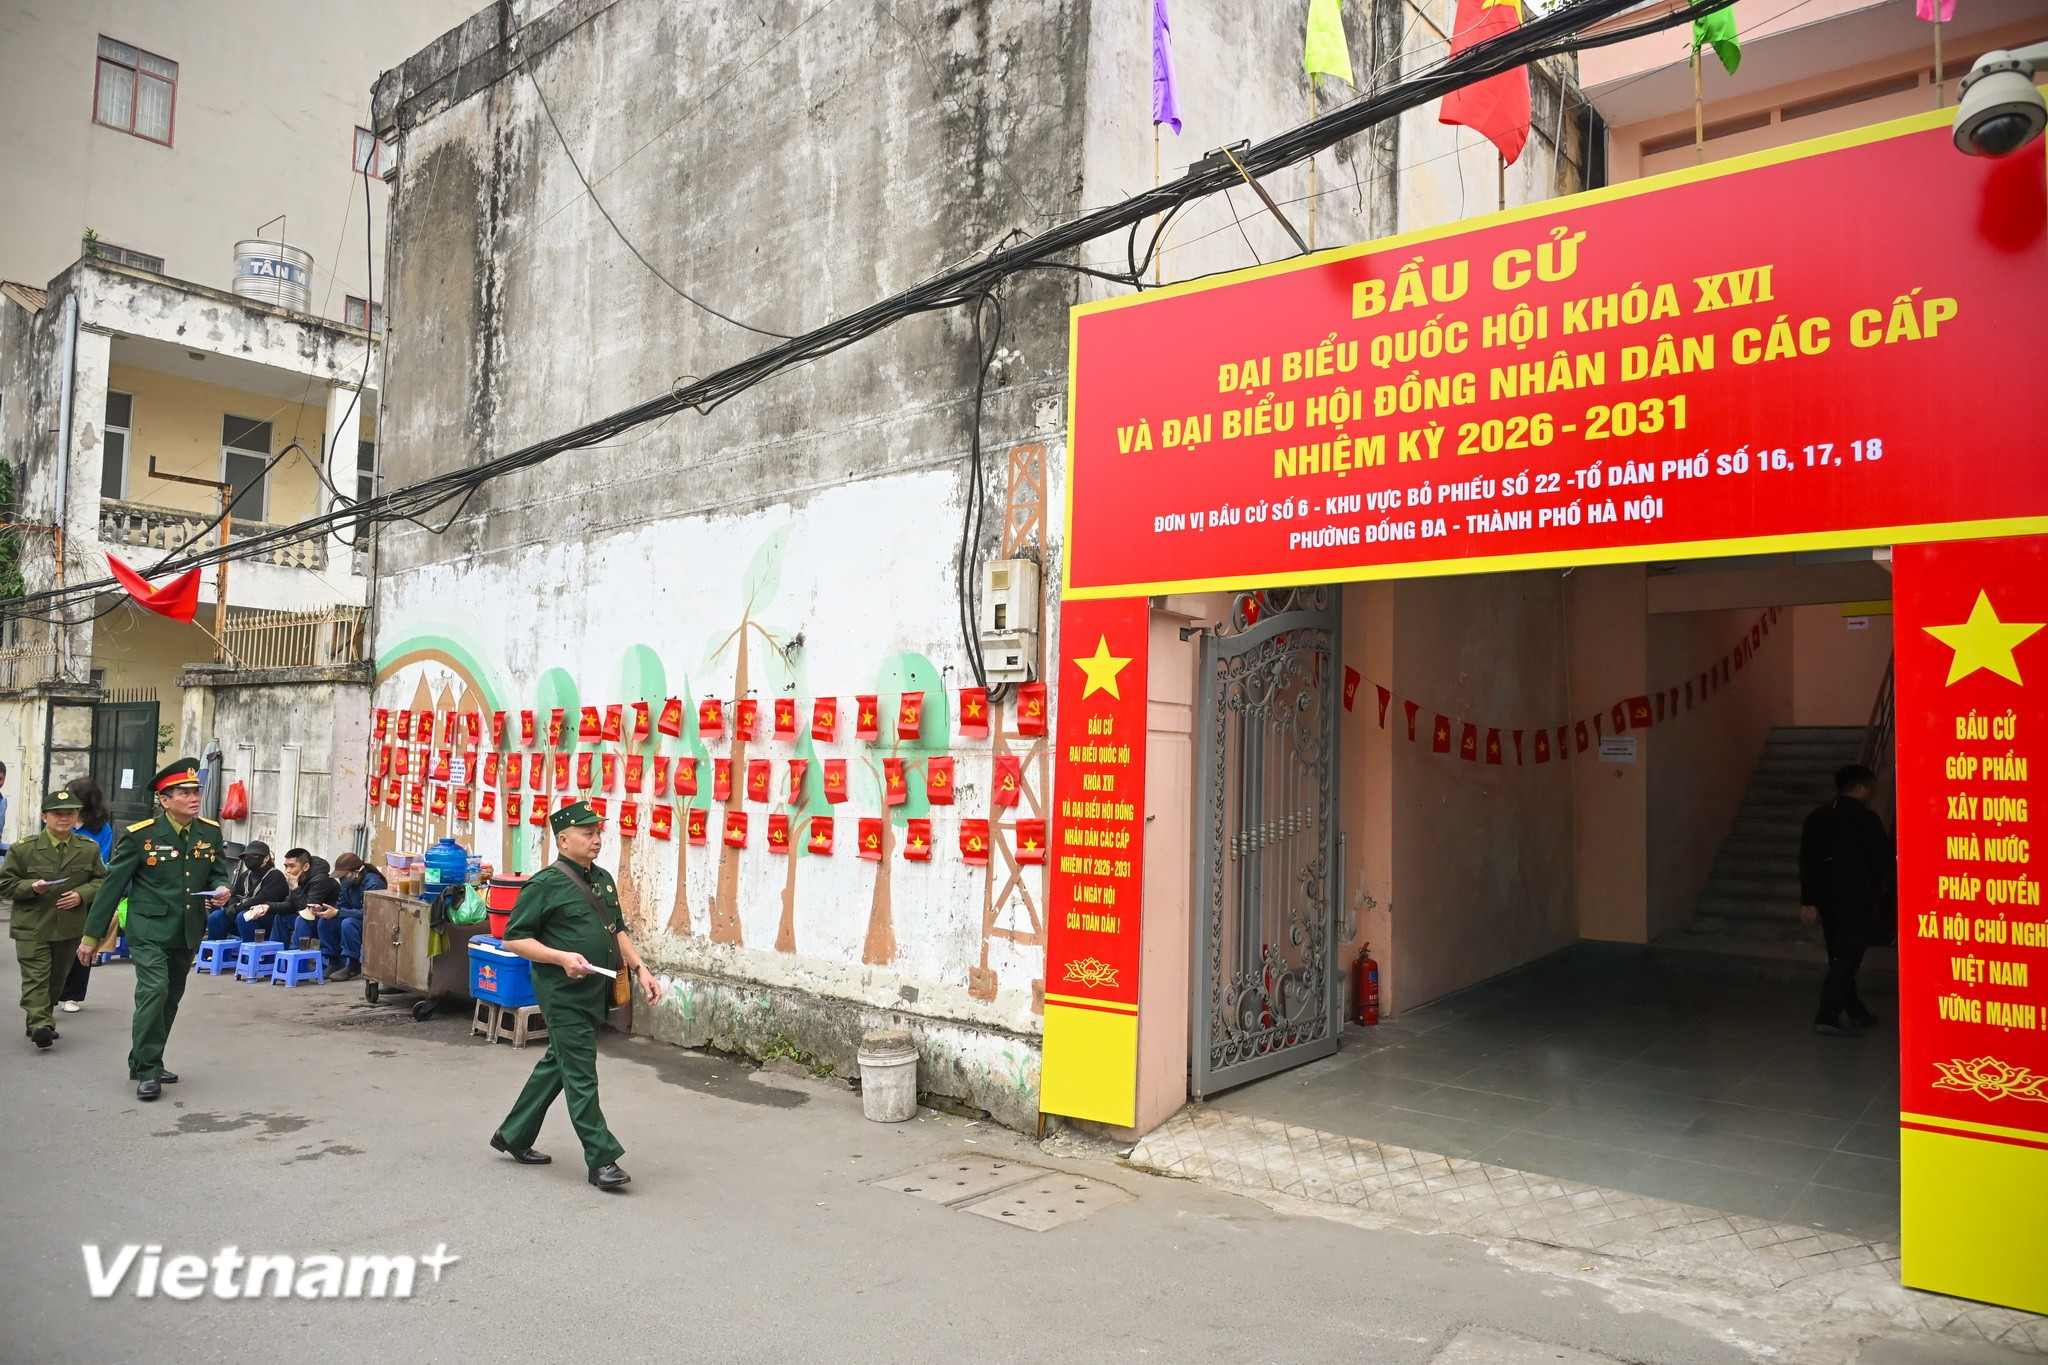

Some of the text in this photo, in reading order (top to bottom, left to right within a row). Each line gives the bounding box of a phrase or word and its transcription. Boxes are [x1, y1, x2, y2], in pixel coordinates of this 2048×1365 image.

[250, 260, 289, 279] TÂN
[1352, 226, 1587, 320] BẦU CỬ
[1219, 264, 1774, 395] ĐẠI BIỂU QUỐC HỘI KHÓA XVI
[1118, 287, 1958, 454] VÀ ĐẠI BIỂU HỘI ĐỒNG NHÂN DÂN CÁC CẤP
[1274, 395, 1685, 477] NHIỆM KỲ 2026 - 2031
[1154, 513, 1185, 532] ĐƠN
[1190, 512, 1204, 531] VỊ
[1209, 503, 1239, 527] BẦU
[1245, 500, 1268, 523] CỬ
[1273, 496, 1294, 519] SỐ
[1298, 499, 1308, 516] 6
[1326, 494, 1361, 515] KHU
[1366, 490, 1400, 512] VỰC
[1408, 481, 1432, 506] BỎ
[1438, 475, 1495, 502] PHIẾU
[1503, 469, 1529, 495] SỐ
[1535, 473, 1559, 492] 22
[1609, 461, 1654, 486] DÂN
[1662, 450, 1709, 480] PHỐ
[1717, 445, 1748, 474] SỐ
[1757, 449, 1794, 470] 16,
[1803, 444, 1841, 465] 17,
[1851, 438, 1881, 461] 18
[1290, 525, 1359, 550] PHƯỜNG
[1365, 518, 1415, 542] ĐỐNG
[1421, 518, 1446, 537] ĐA
[1466, 509, 1531, 533] THÀNH
[1539, 499, 1581, 526] PHỐ
[1589, 499, 1617, 523] HÀ
[1625, 495, 1662, 523] NỘI
[1088, 713, 1114, 735] BẦU CỬ
[1956, 709, 2016, 740] BẦU CỬ
[1069, 740, 1130, 767] ĐẠI BIỂU QUỐC HỘI
[1946, 749, 2027, 780] GÓP PHẦN
[1083, 771, 1114, 791] KHÓA XVI
[1063, 796, 1134, 823] VÀ ĐẠI BIỂU HỘI ĐỒNG
[1948, 792, 2027, 826] XÂY DỰNG
[1065, 826, 1129, 848] NHÂN DÂN CÁC CẤP
[1947, 833, 2029, 863] NHÀ NƯỚC
[1061, 854, 1082, 877] NHIỆM
[1083, 855, 1092, 874] KỲ
[1094, 859, 1110, 876] 2026
[1114, 861, 1130, 877] 2031
[1074, 882, 1115, 908] LÀ NGÀY HỘI
[1939, 873, 2039, 905] PHÁP QUYỀN
[1067, 908, 1080, 929] CỦA
[1082, 911, 1099, 931] TOÀN
[1101, 913, 1115, 933] DÂN
[1918, 911, 1938, 938] XÃ
[1944, 913, 1969, 945] HỘI
[1975, 913, 2006, 944] CHỦ
[1951, 954, 2027, 987] VIỆT NAM
[1939, 993, 1981, 1023] VỮNG
[1987, 1002, 2035, 1032] MẠNH
